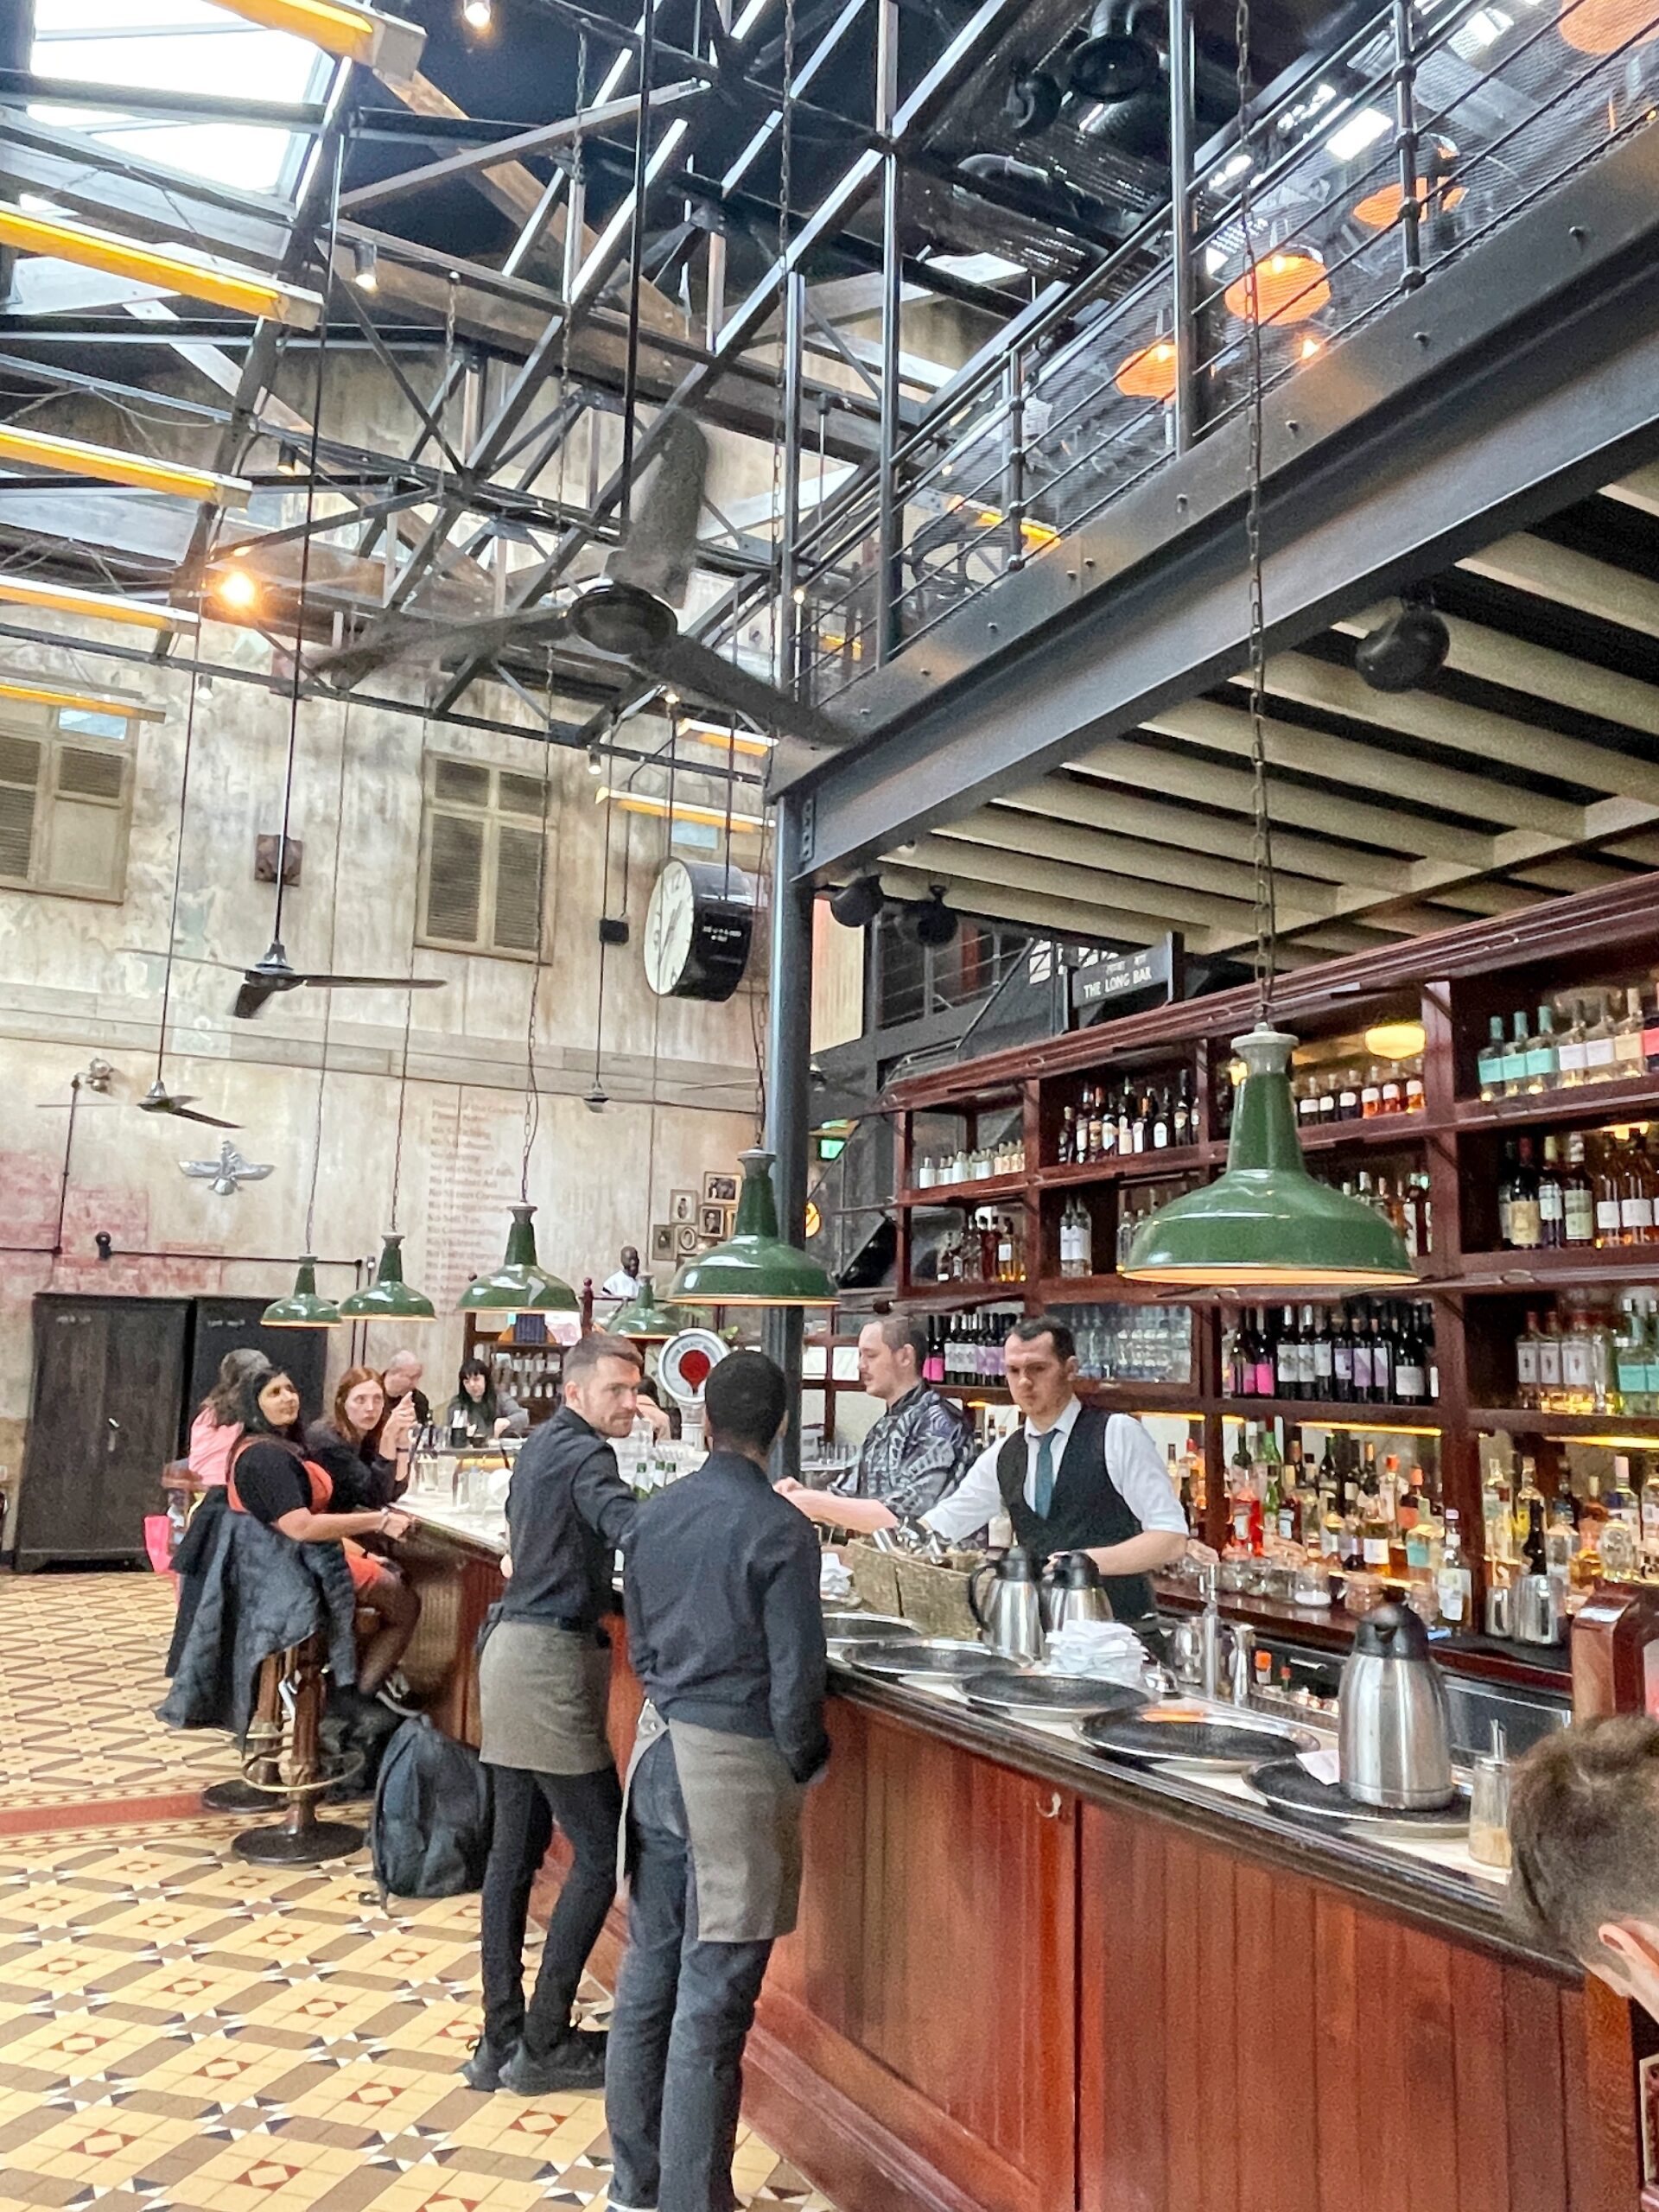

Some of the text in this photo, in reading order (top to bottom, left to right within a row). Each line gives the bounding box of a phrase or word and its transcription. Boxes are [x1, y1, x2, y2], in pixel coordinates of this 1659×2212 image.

[1084, 981, 1102, 999] THE
[1105, 973, 1130, 993] LONG
[1133, 966, 1152, 984] BAR
